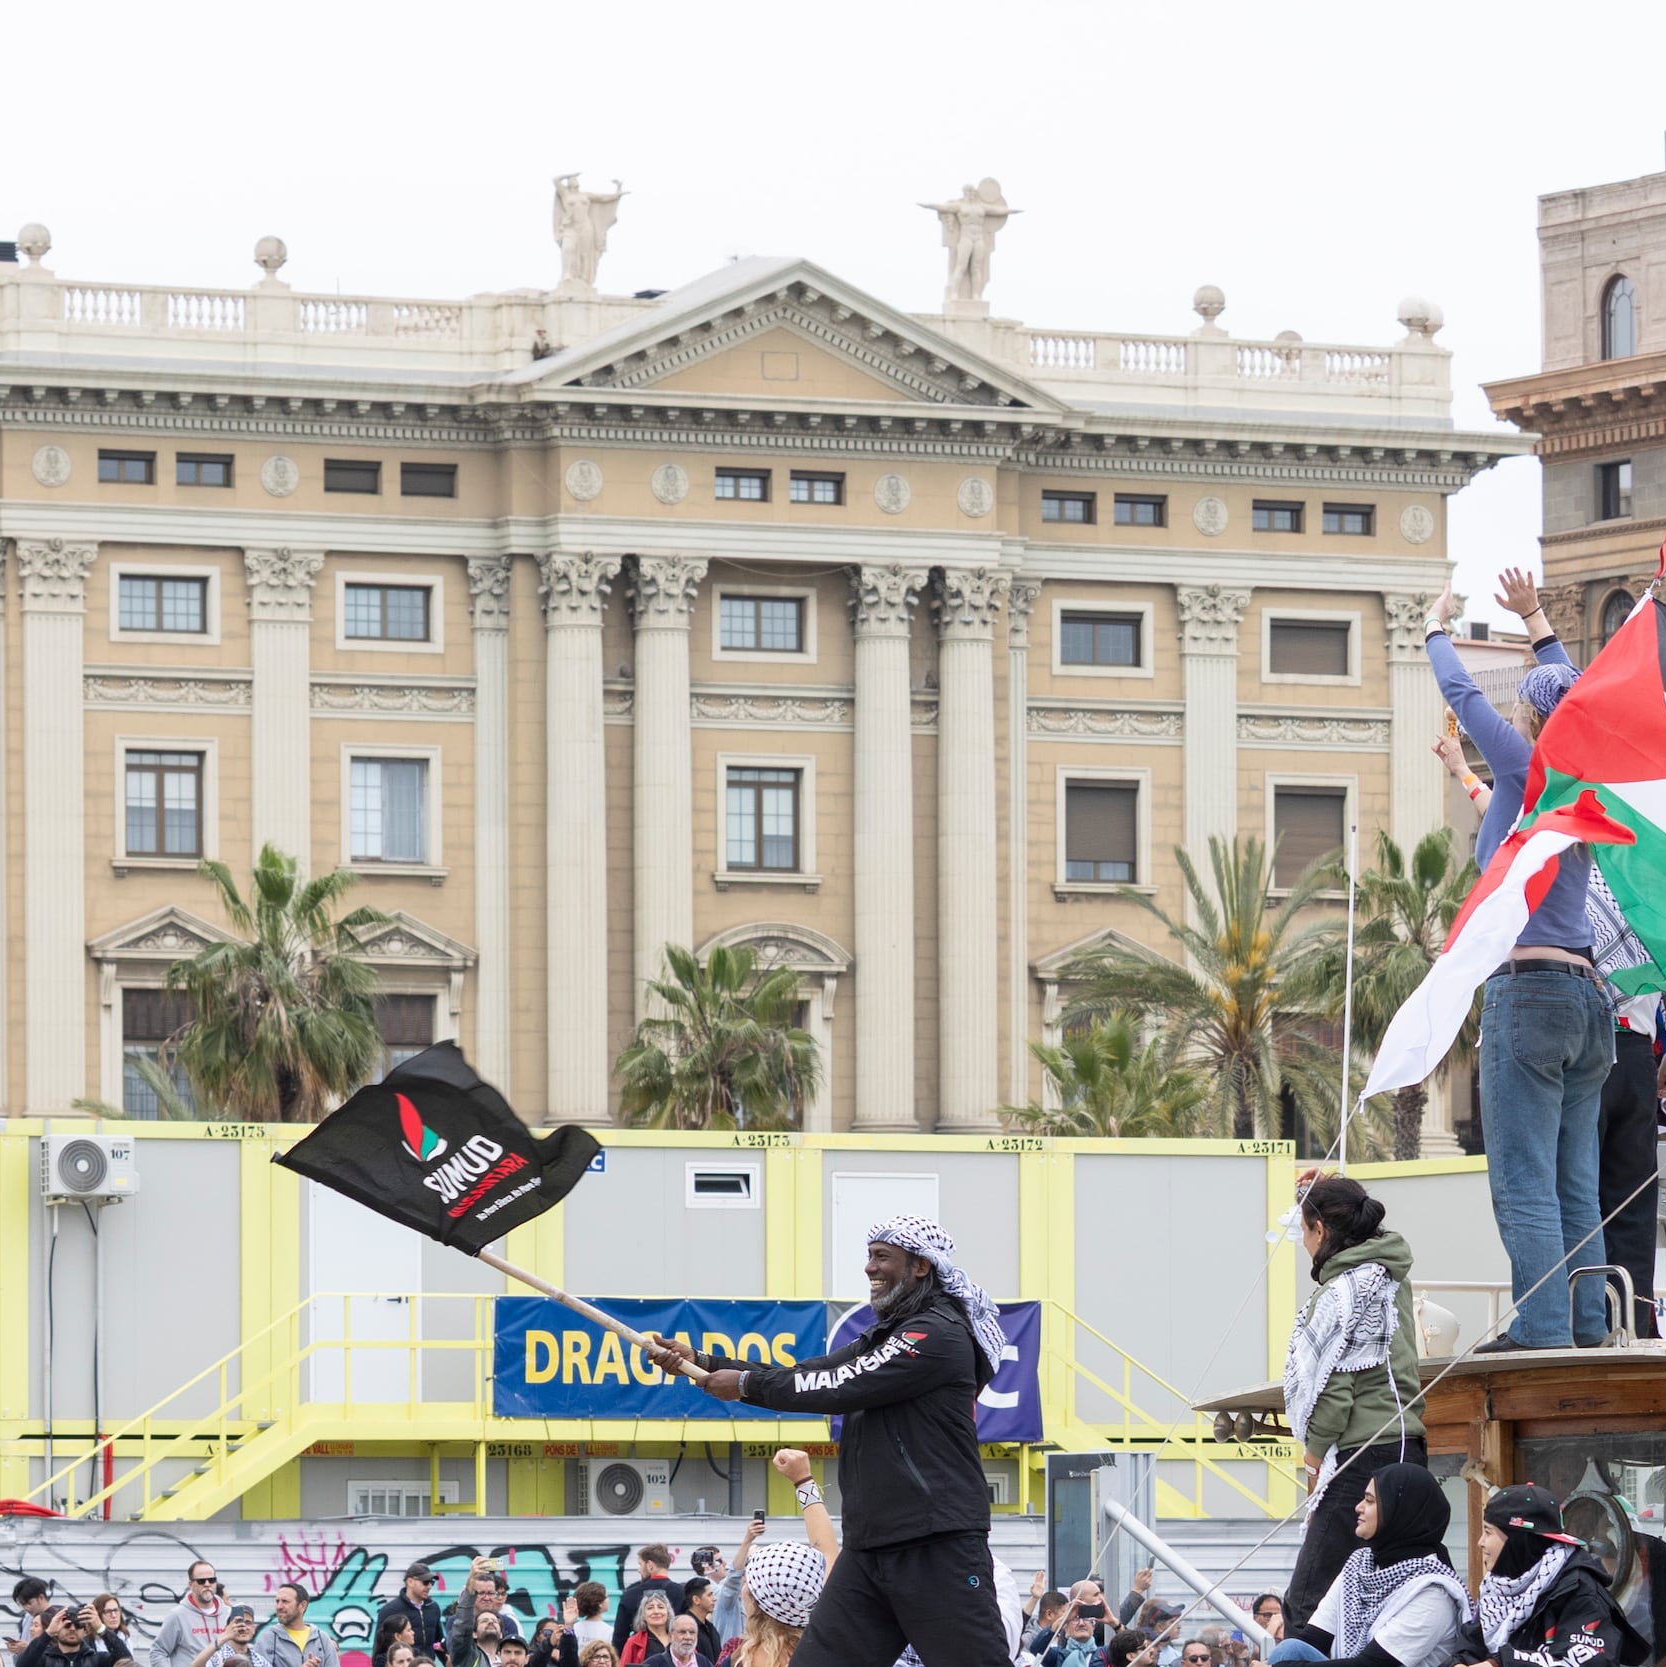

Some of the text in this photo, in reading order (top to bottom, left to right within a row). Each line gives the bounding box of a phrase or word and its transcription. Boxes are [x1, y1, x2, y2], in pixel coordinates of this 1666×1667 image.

[110, 1149, 130, 1161] 107
[794, 1344, 901, 1393] MALAYSIA
[646, 1474, 667, 1484] 102
